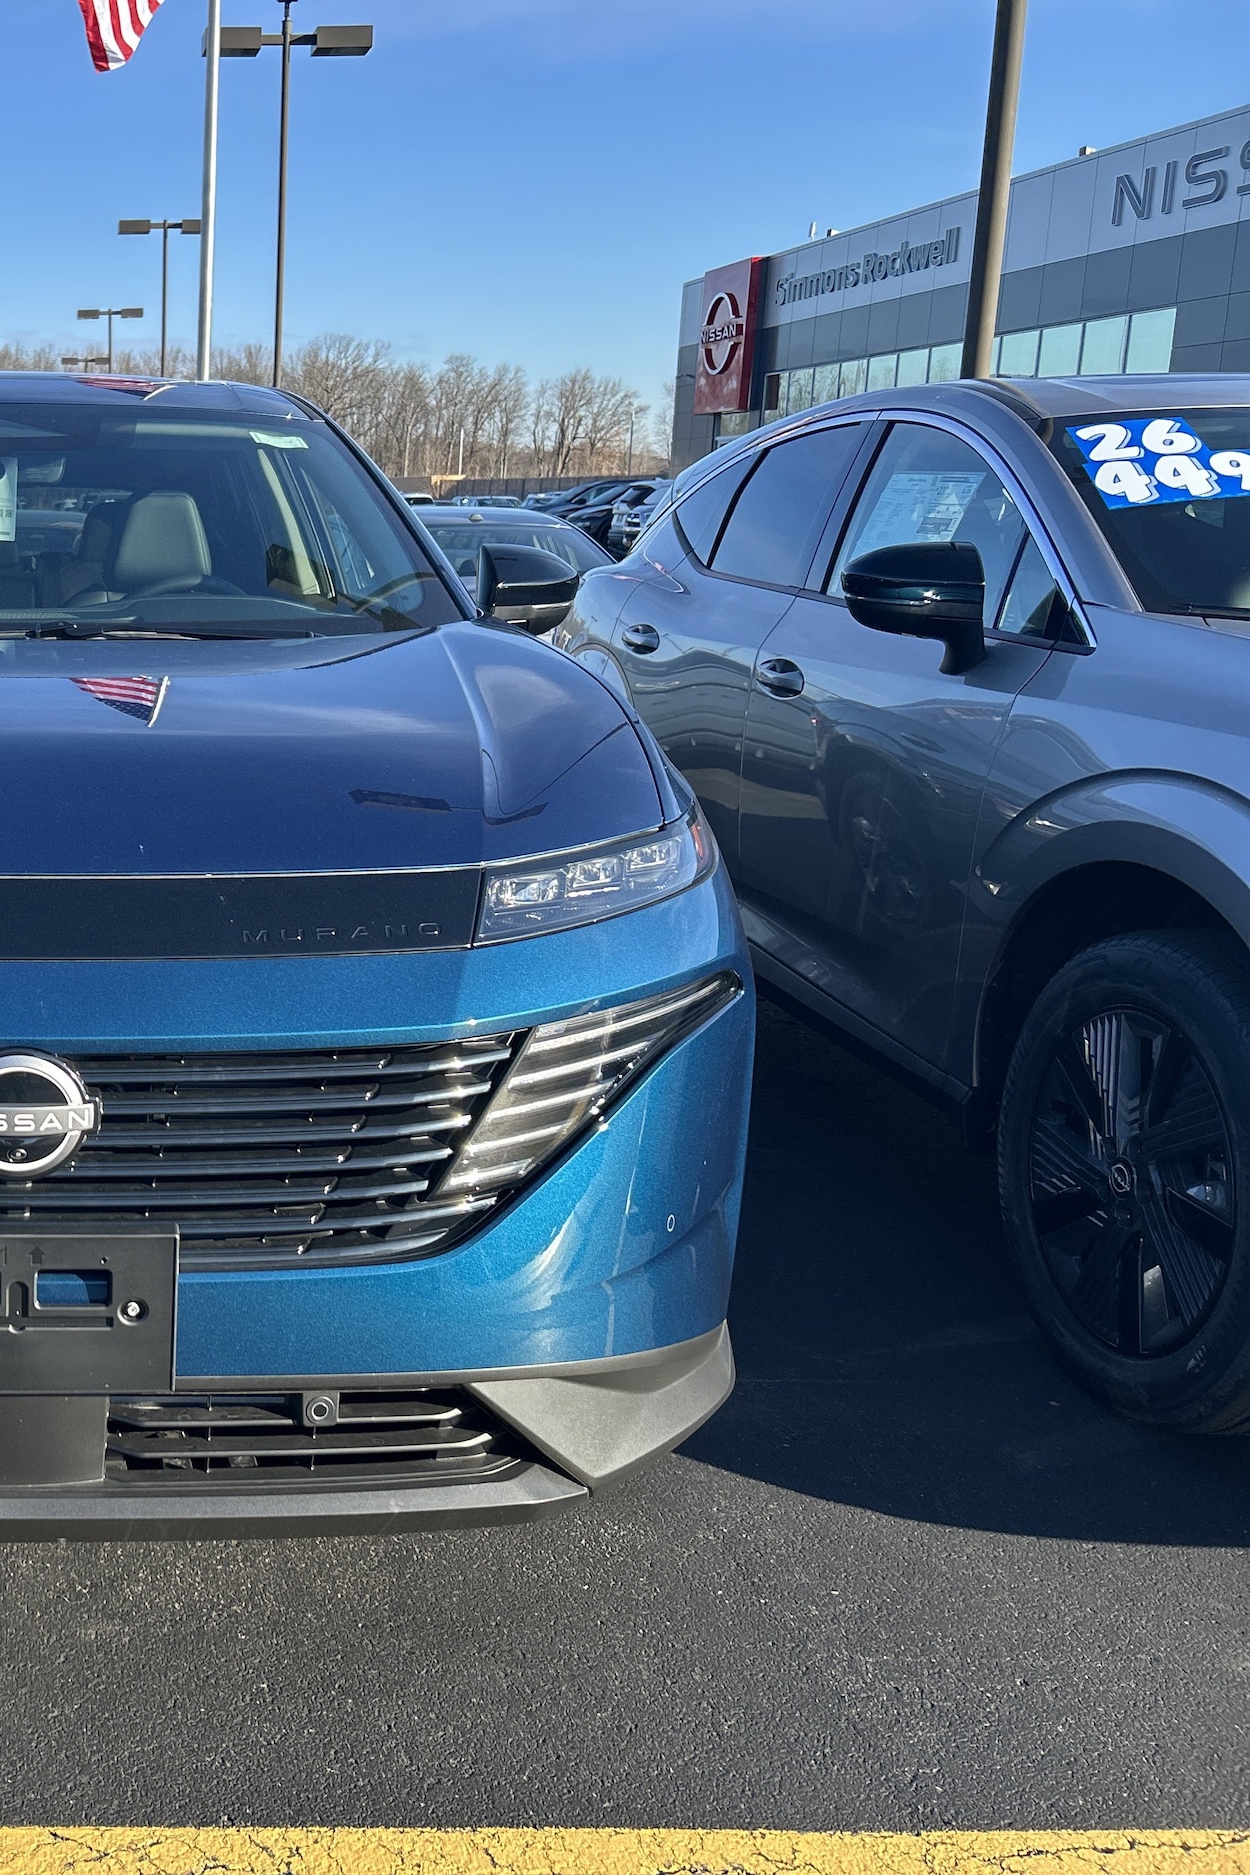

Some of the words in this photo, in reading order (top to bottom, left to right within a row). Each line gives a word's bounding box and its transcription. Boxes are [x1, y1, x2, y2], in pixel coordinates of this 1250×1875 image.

[775, 261, 861, 306] Simmons
[861, 226, 961, 285] Rockwell
[701, 323, 737, 344] NISSAN
[1075, 418, 1203, 462] 26
[242, 922, 442, 943] MURANO
